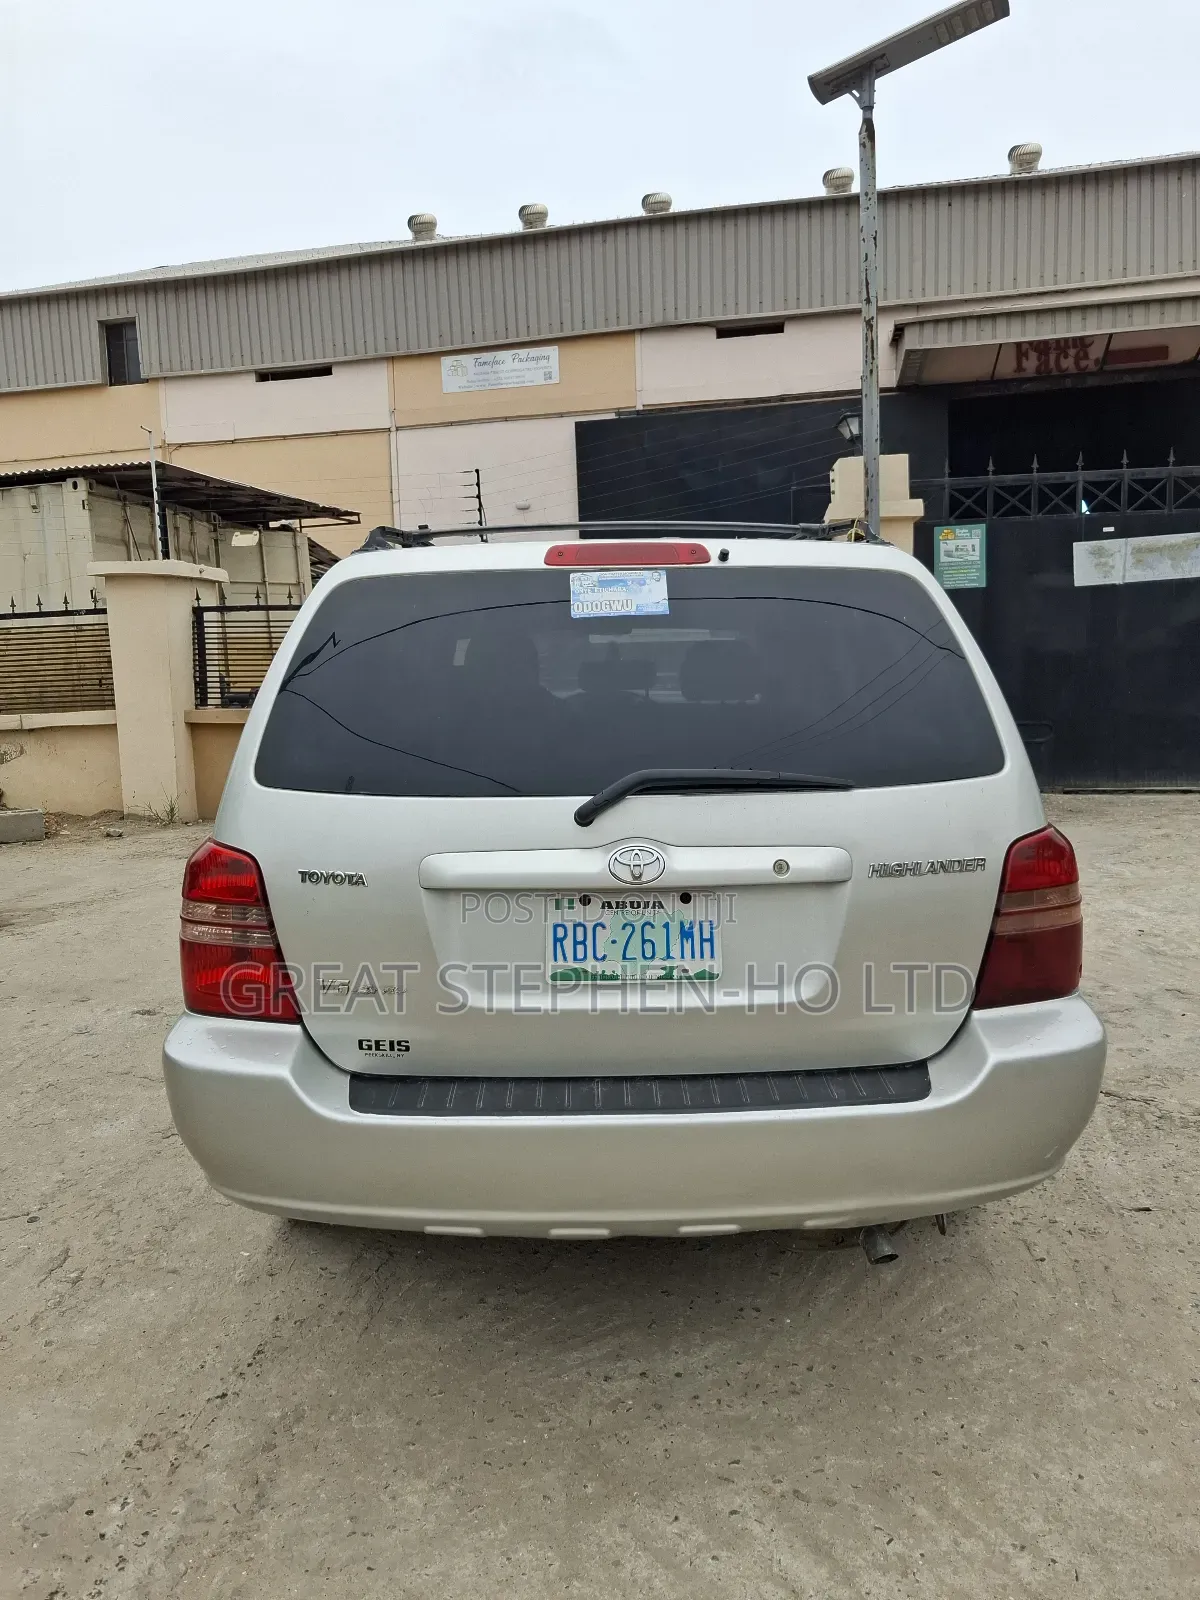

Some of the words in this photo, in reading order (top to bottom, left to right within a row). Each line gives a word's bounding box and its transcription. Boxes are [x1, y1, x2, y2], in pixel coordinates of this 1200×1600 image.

[473, 356, 505, 369] Fameface
[511, 352, 550, 367] Packaging
[573, 600, 632, 613] ODOGWU
[868, 857, 986, 878] HIGHLANDER
[298, 869, 368, 887] TOYOTA
[600, 900, 664, 910] ABUJA
[358, 1039, 411, 1052] GEIS
